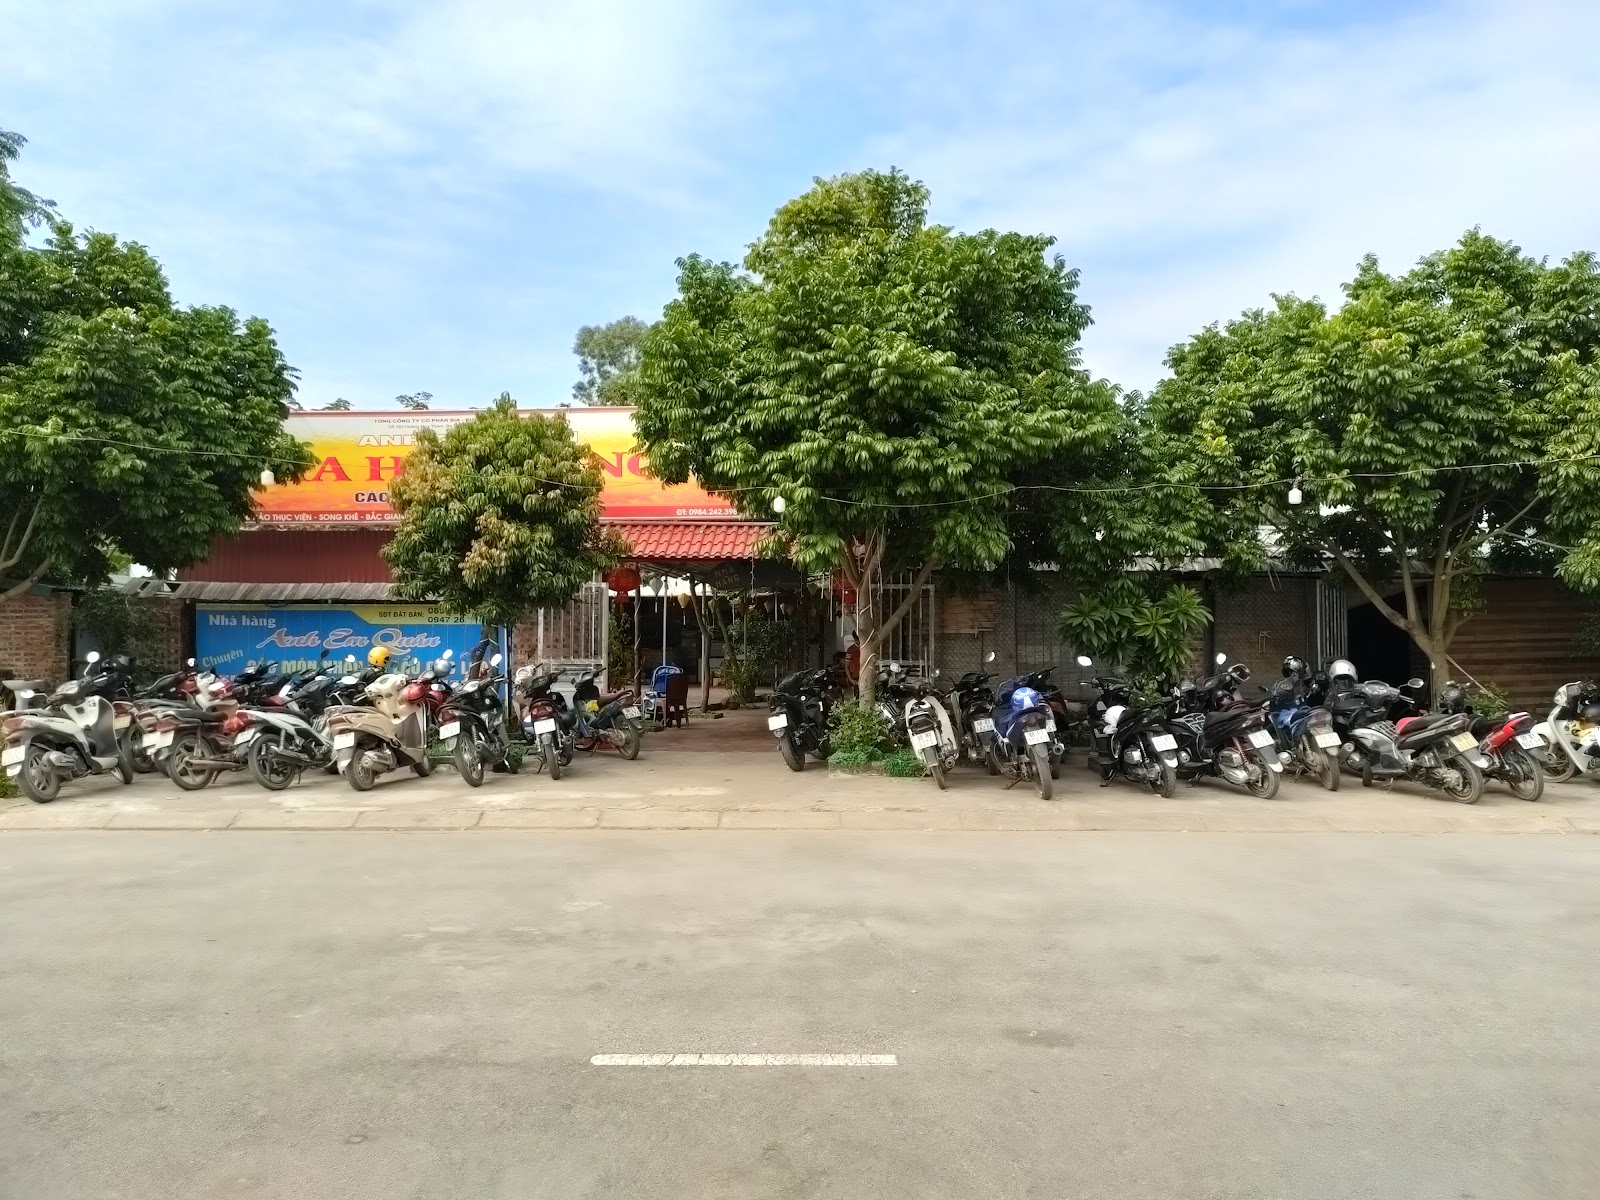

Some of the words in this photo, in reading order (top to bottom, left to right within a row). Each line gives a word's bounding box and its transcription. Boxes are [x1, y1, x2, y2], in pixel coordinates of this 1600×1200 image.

[358, 435, 421, 446] ANH
[272, 514, 293, 522] THỤC
[295, 512, 312, 522] VIỆN
[319, 513, 342, 521] SONG
[344, 511, 358, 520] KHÊ
[366, 511, 382, 521] BẮC
[208, 614, 238, 626] Nhà
[241, 615, 277, 629] hàng
[256, 628, 321, 649] Anh
[323, 628, 370, 649] Em
[372, 628, 442, 656] Quán
[202, 649, 244, 668] Chuyên
